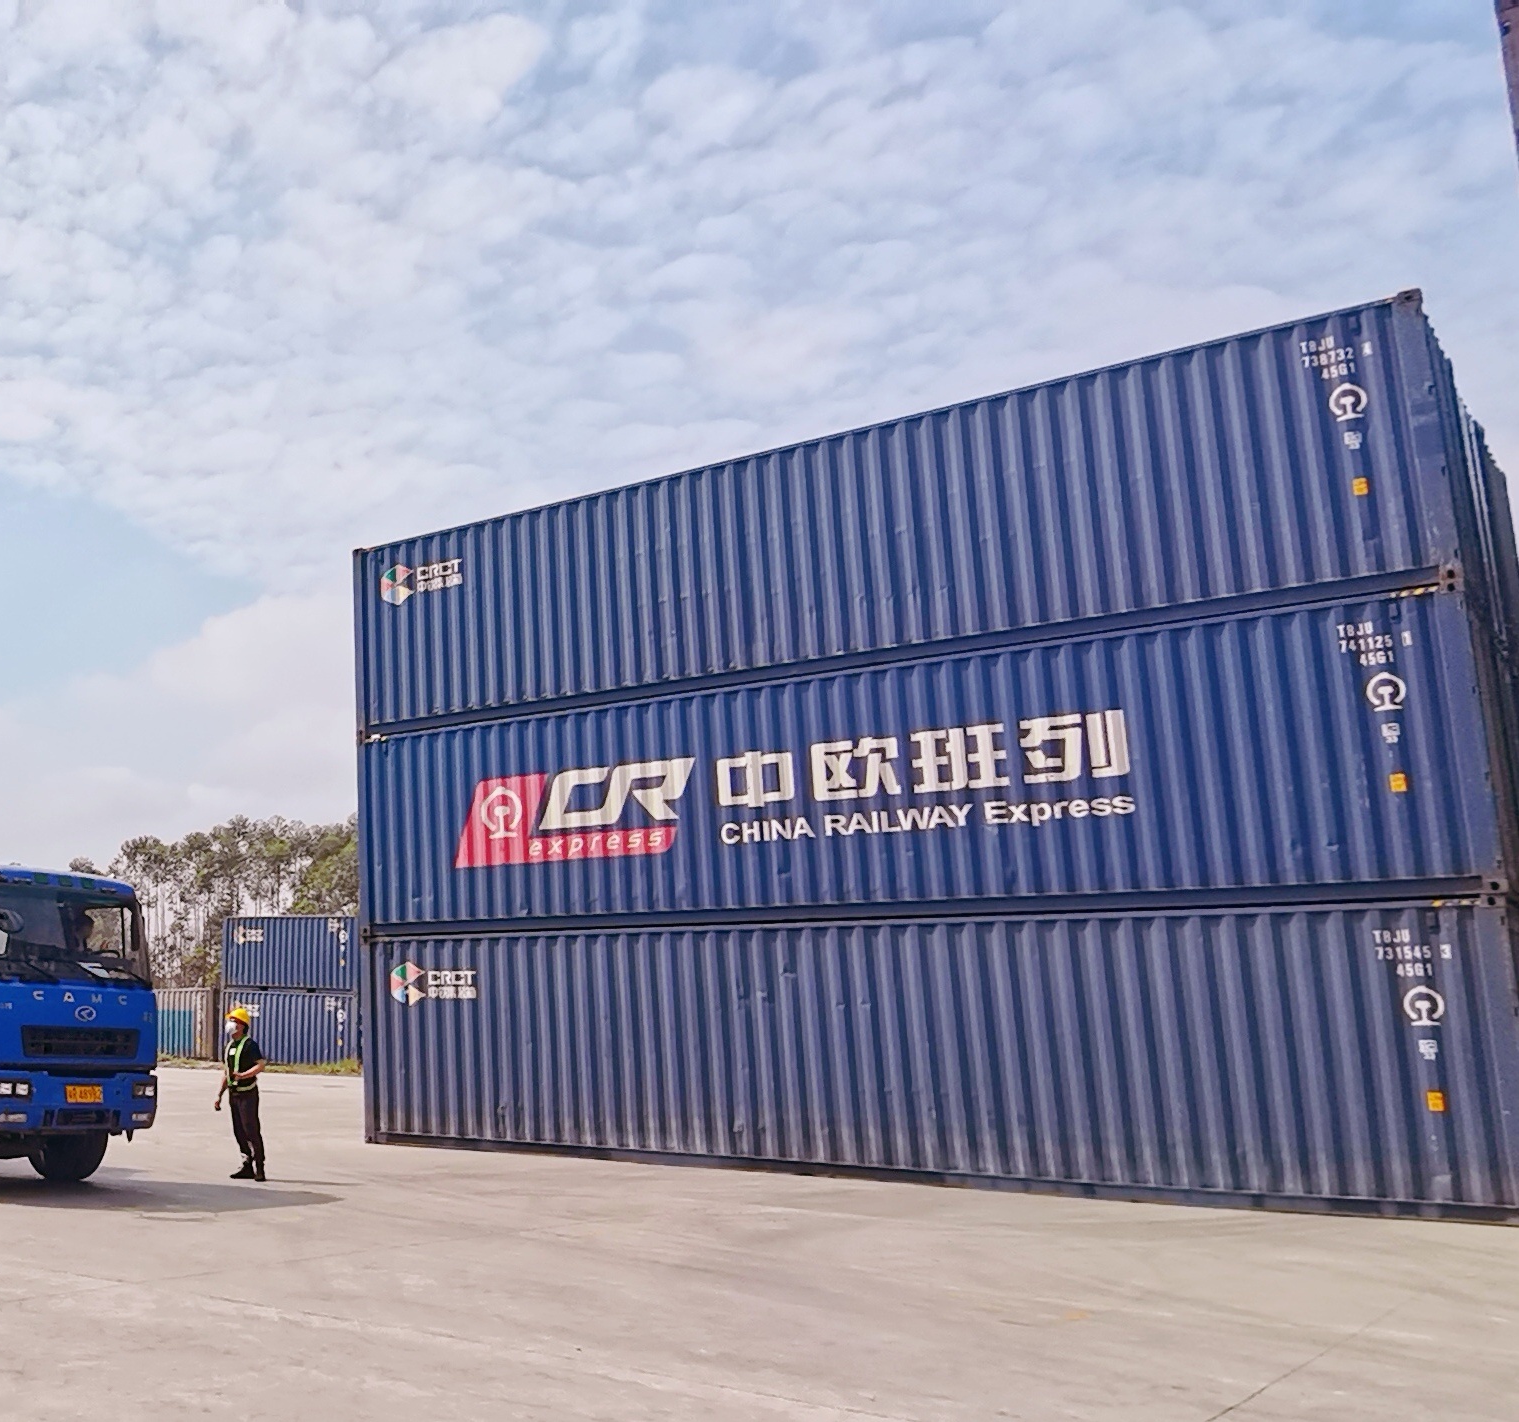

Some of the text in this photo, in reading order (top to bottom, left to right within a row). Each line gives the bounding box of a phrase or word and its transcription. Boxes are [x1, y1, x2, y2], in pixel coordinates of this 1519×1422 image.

[1302, 346, 1354, 368] 738732
[1321, 361, 1355, 380] 45G1
[416, 558, 462, 581] CRCT
[1338, 634, 1394, 653] 741125
[1359, 650, 1394, 667] 45G1
[715, 708, 1132, 808] 中欧班列
[538, 757, 695, 831] CR
[719, 795, 1137, 846] CHINA RAILWAY Express
[529, 829, 663, 857] express
[1374, 945, 1432, 960] 731545
[427, 970, 477, 985] CRCT
[1395, 962, 1433, 977] 45G1
[32, 989, 128, 1006] CAMC
